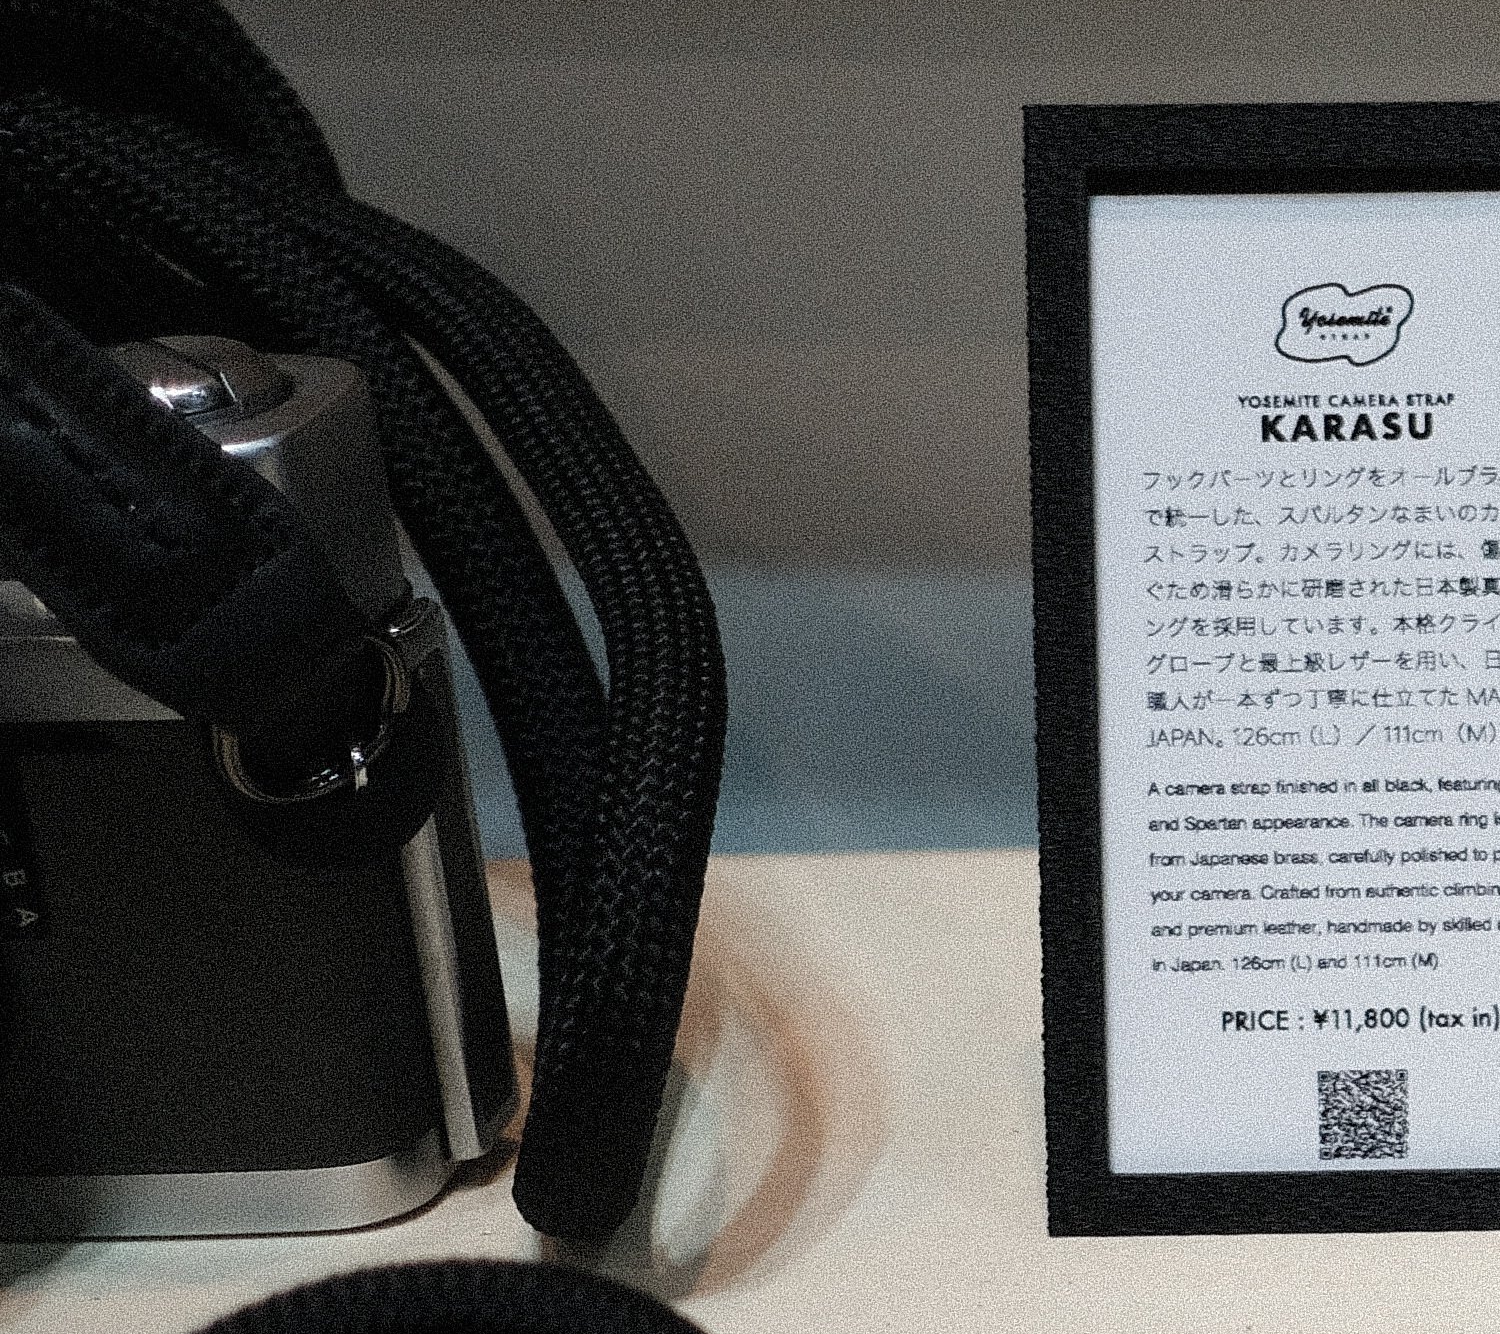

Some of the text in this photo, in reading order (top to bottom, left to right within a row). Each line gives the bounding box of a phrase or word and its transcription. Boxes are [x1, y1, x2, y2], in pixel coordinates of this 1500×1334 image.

[1299, 306, 1391, 335] Yosemite
[1238, 393, 1456, 411] YOSEMITE CAMERA STRAP
[1261, 411, 1435, 445] KARASU
[1385, 725, 1444, 745] 111cm
[1148, 782, 1162, 798] A
[1165, 783, 1227, 798] camera
[1231, 782, 1272, 798] strap
[1276, 779, 1340, 796] finished
[1344, 782, 1358, 795] in
[1362, 778, 1381, 795] all
[1148, 818, 1181, 833] and
[1184, 816, 1248, 835] Spartan
[1359, 812, 1391, 830] The
[1393, 815, 1455, 830] camera
[1459, 811, 1490, 831] ring
[1149, 852, 1187, 869] from
[1190, 853, 1271, 871] Japanese
[1328, 849, 1397, 868] carefully
[1401, 847, 1470, 867] polished
[1473, 848, 1490, 863] to
[1150, 890, 1187, 907] your
[1260, 884, 1321, 902] Crafted
[1325, 885, 1362, 901] from
[1365, 884, 1440, 900] authentic
[1151, 923, 1184, 939] and
[1188, 924, 1259, 941] premium
[1327, 919, 1415, 936] handmade
[1418, 919, 1439, 937] by
[1443, 917, 1493, 934] skilled
[1152, 959, 1167, 973] in
[1317, 955, 1349, 972] and
[1355, 954, 1408, 971] 111cm
[1222, 1009, 1291, 1034] PRICE
[1313, 1007, 1412, 1035] ¥11,800
[1420, 1005, 1466, 1035] (tax
